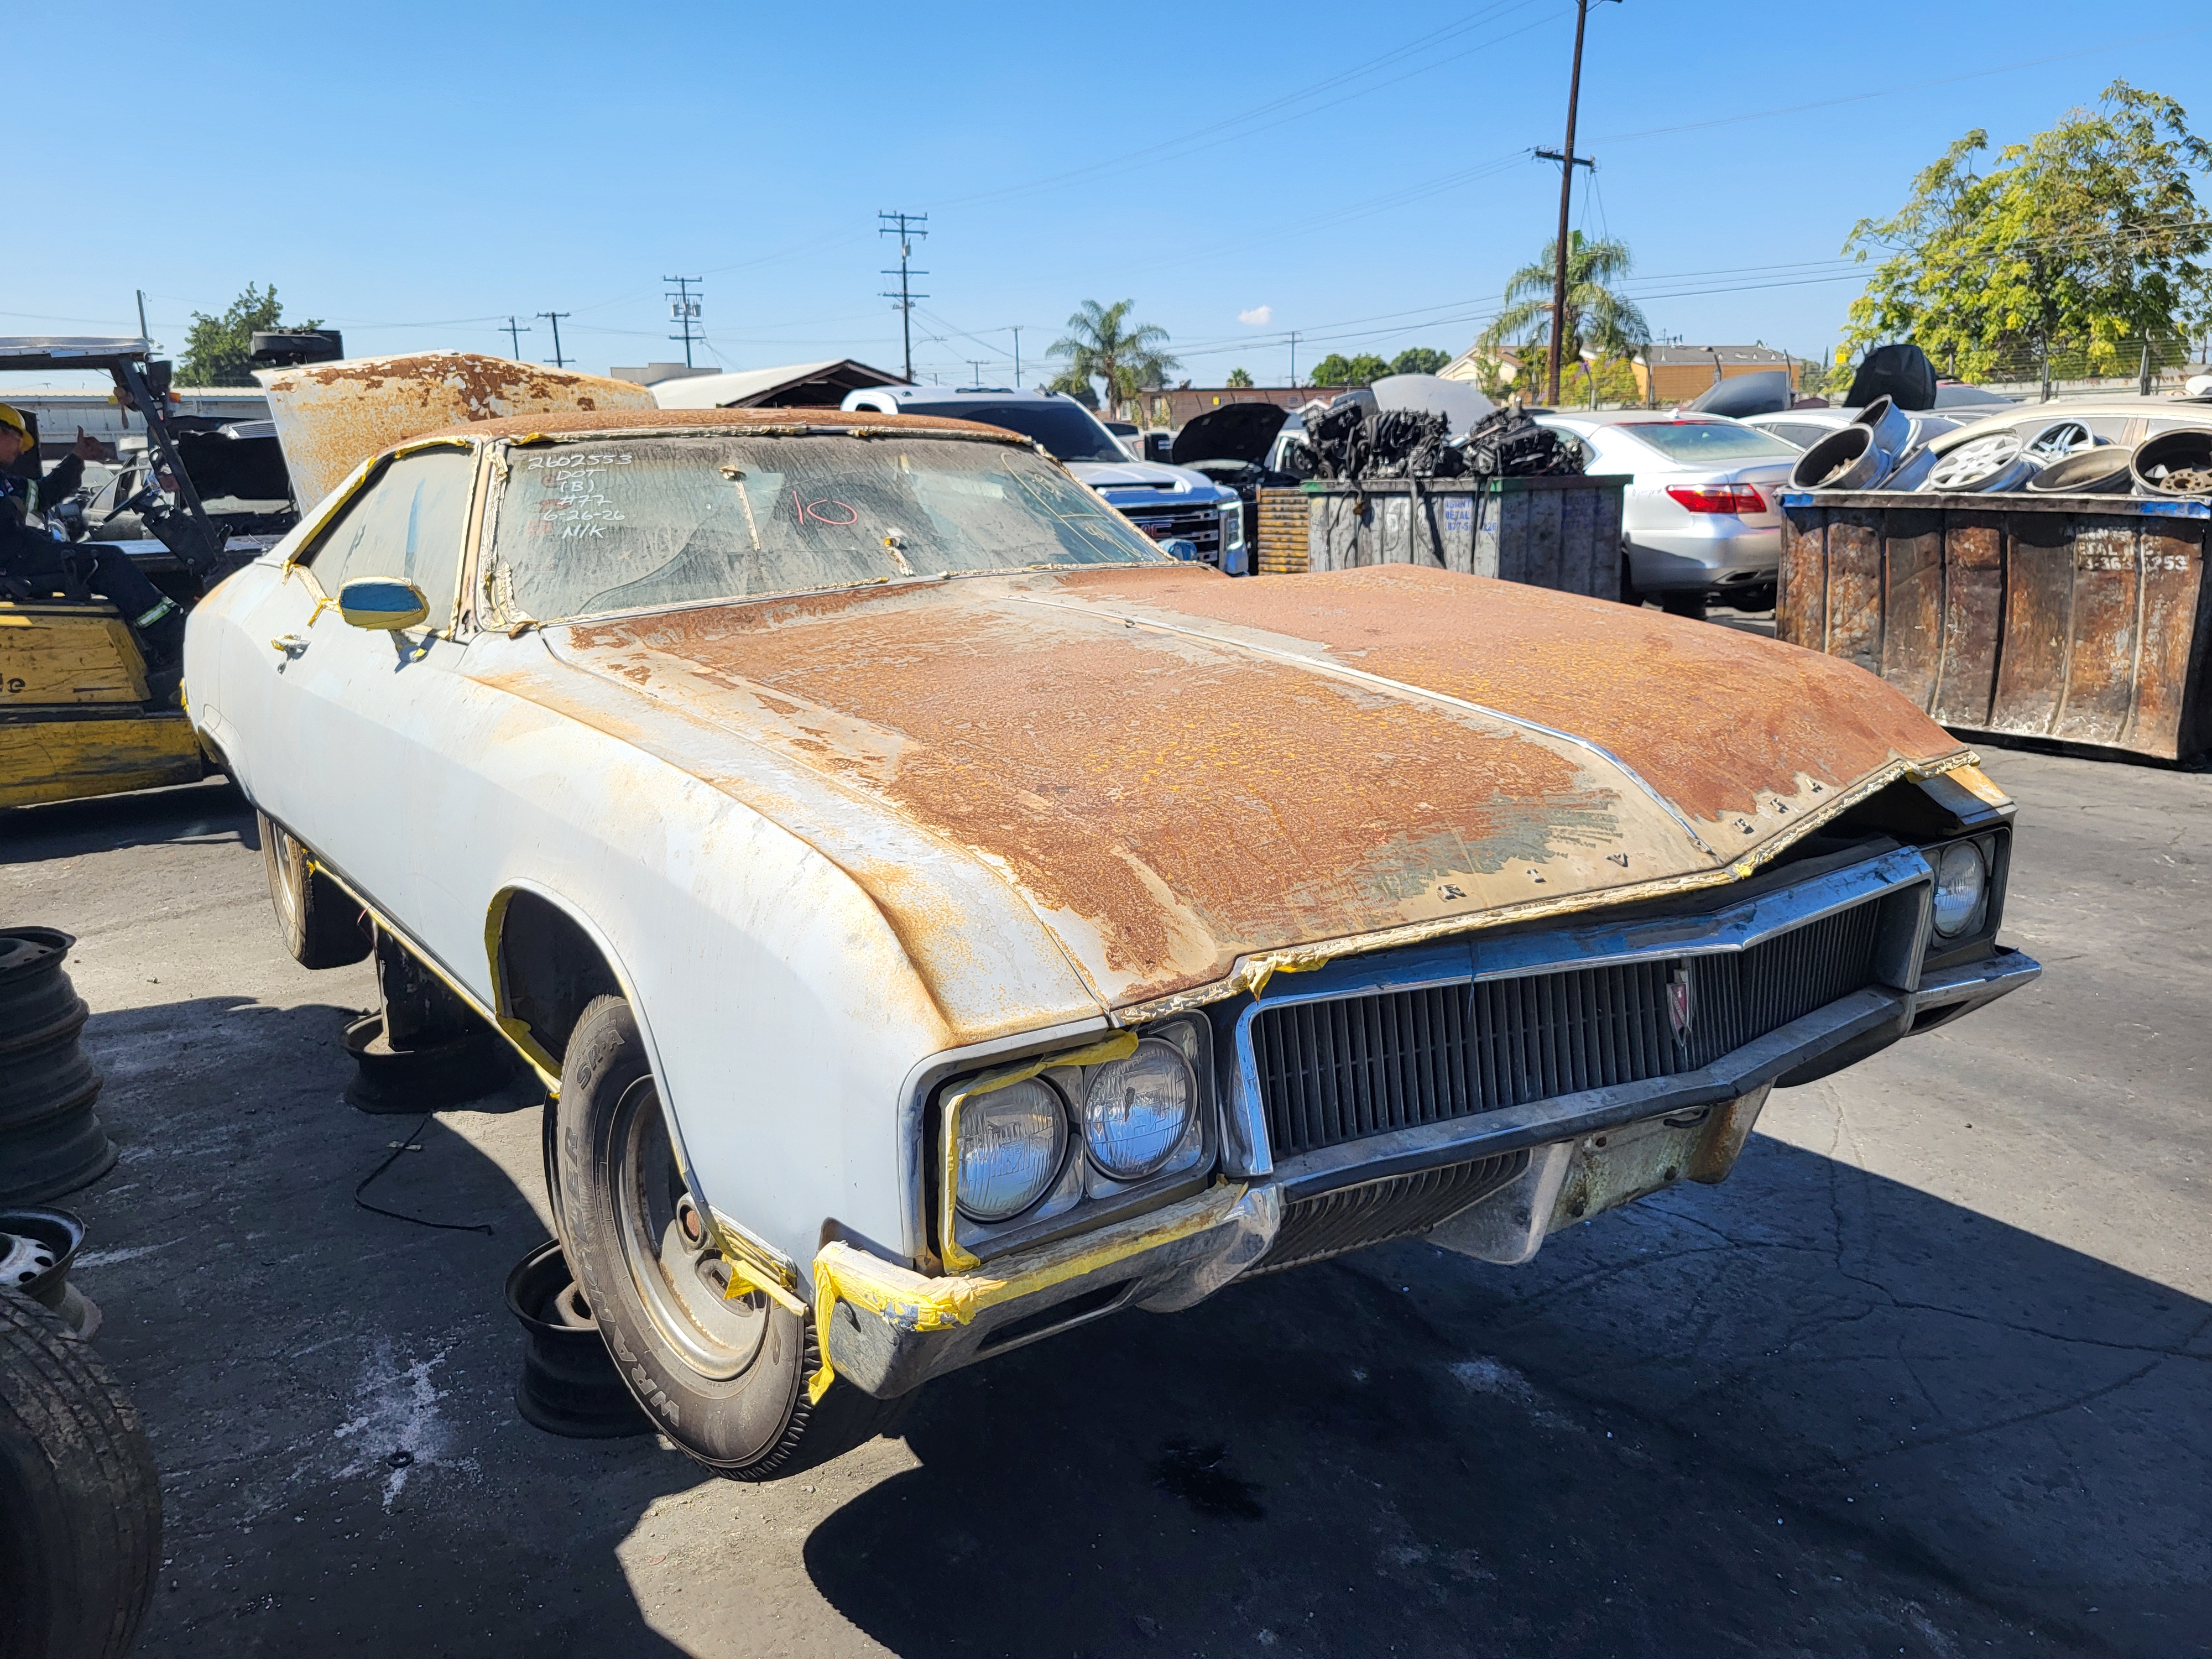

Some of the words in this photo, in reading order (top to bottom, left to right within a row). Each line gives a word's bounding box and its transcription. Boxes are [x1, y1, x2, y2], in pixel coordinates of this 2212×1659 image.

[528, 455, 633, 470] 2602553
[556, 469, 607, 481] DOT
[560, 479, 594, 493] (B)
[792, 490, 858, 525] 10
[543, 510, 625, 521] 6-26-26
[561, 523, 607, 539] N/K
[1437, 777, 1823, 900] RIVIERA
[565, 1125, 680, 1427] WRANGLER
